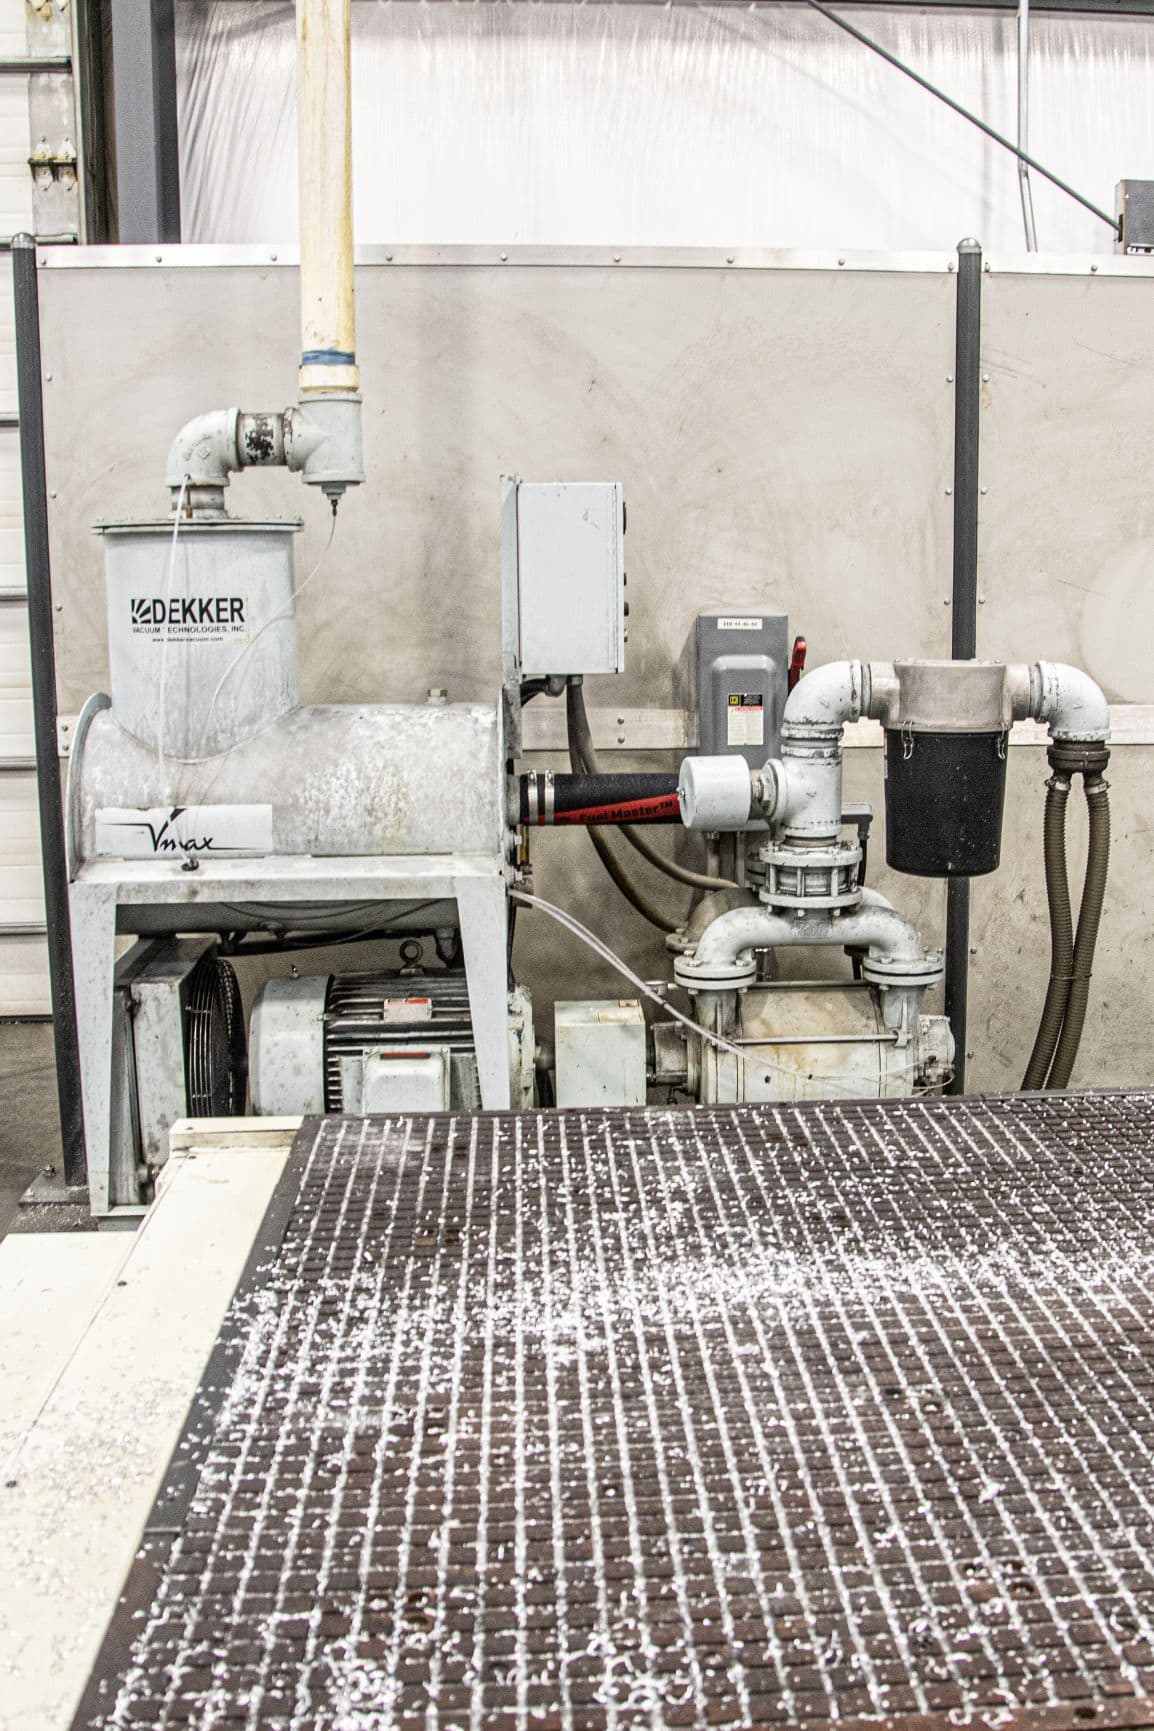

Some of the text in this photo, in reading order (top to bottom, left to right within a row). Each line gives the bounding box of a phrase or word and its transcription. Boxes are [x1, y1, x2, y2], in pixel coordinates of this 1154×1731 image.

[152, 597, 245, 624] DEKKER
[162, 625, 229, 634] ECHNOLOGIES,
[580, 811, 608, 824] Fuel
[148, 807, 214, 851] Vmax
